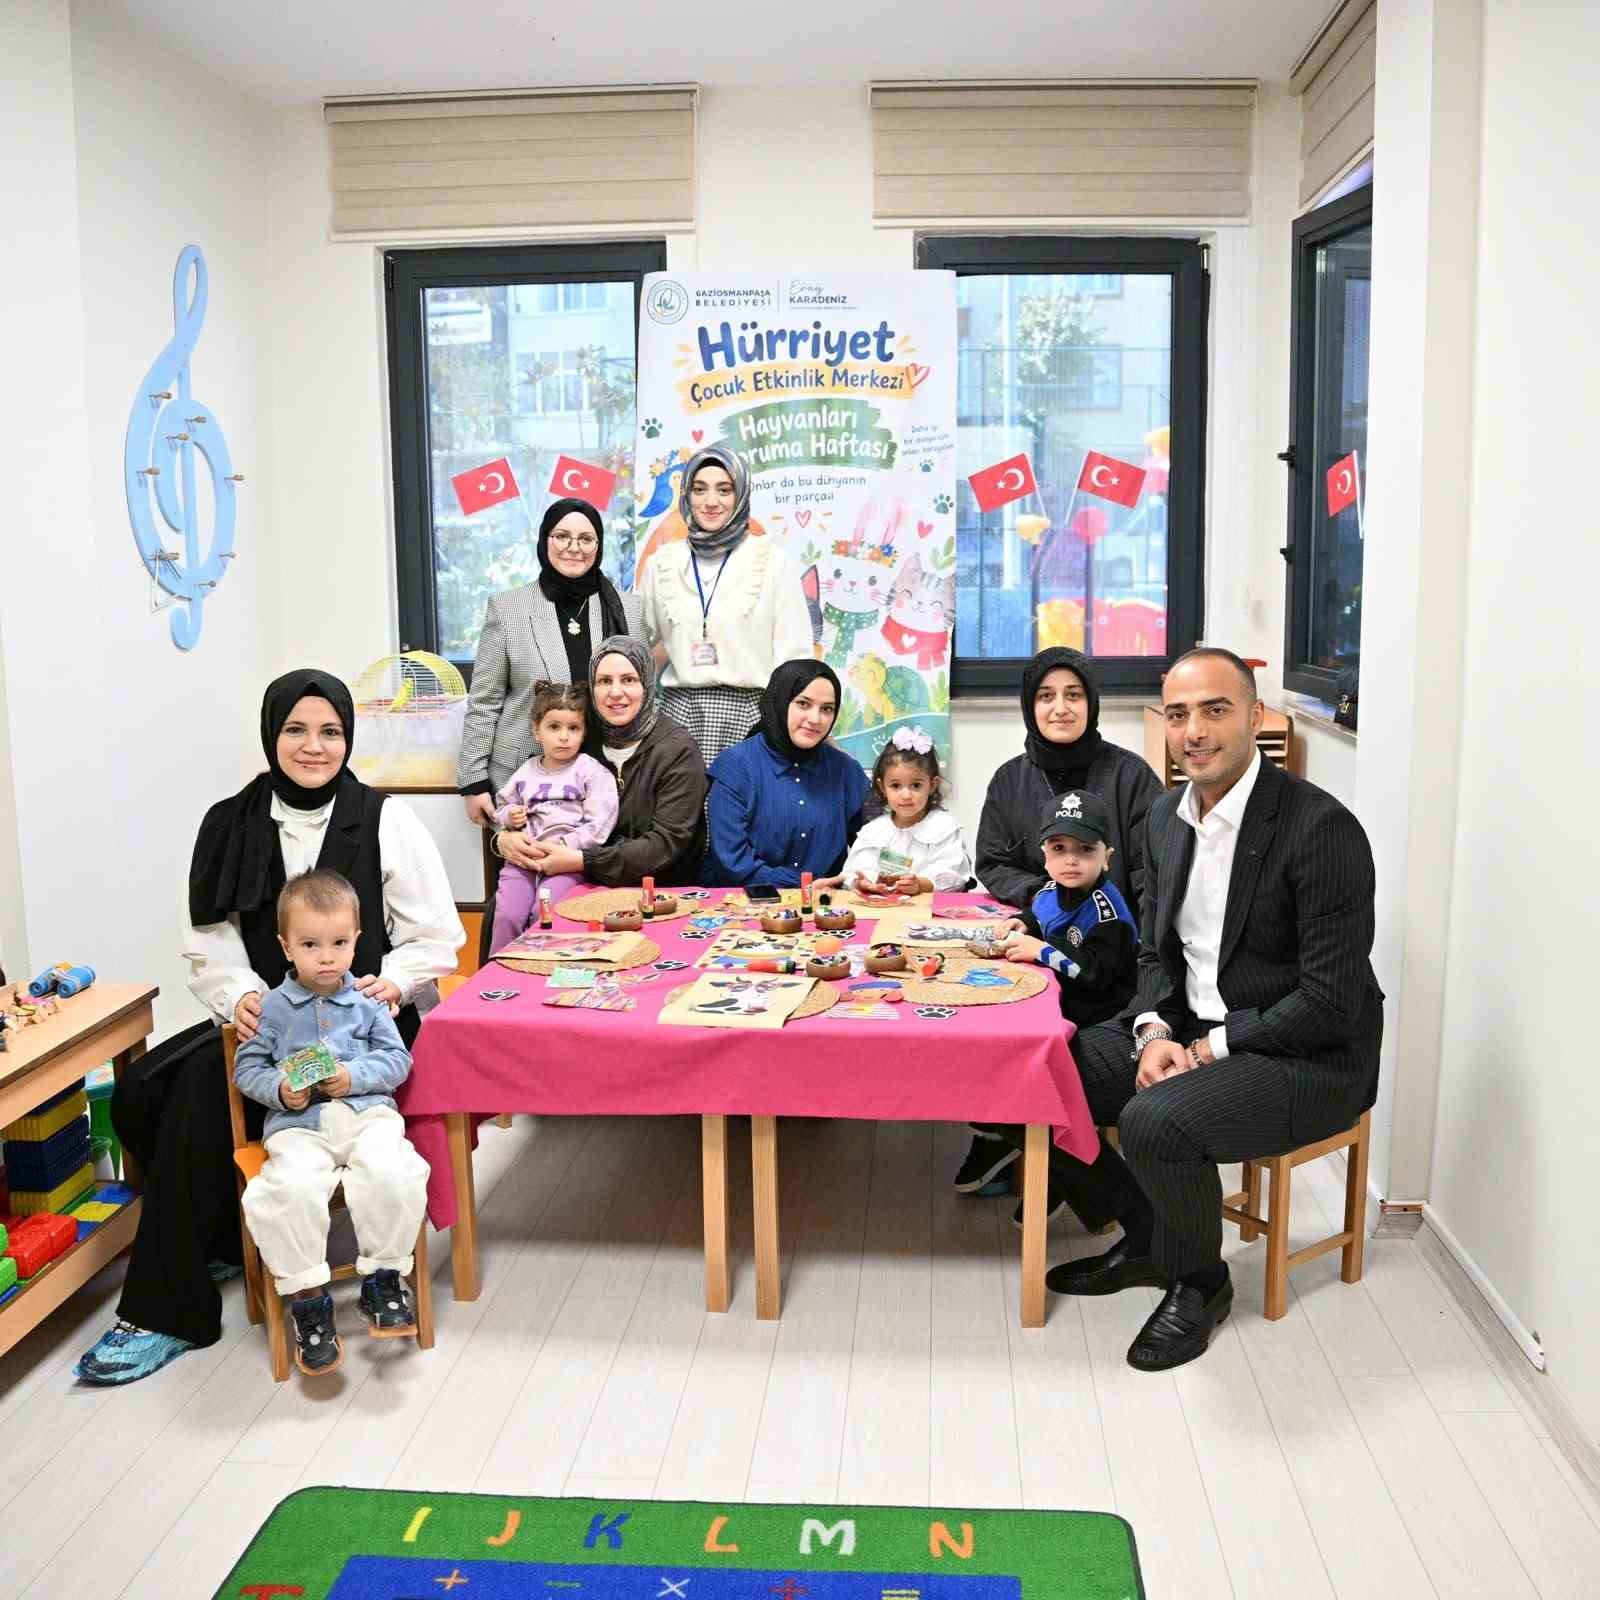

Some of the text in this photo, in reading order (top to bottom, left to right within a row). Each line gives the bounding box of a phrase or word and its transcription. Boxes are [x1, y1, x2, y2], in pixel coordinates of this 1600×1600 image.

[696, 297, 771, 307] BELEDİYESİ
[789, 293, 848, 304] KARADENİZ
[698, 321, 895, 371] Hürriyet
[691, 368, 904, 408] Çocuk Etkinlik Merkezi
[738, 405, 857, 441] Hayvanları
[738, 438, 804, 465] oruma
[811, 431, 888, 460] Haftası
[775, 491, 790, 504] bir
[780, 475, 794, 489] da
[799, 475, 812, 487] bu
[816, 474, 866, 488] dünyanın
[486, 1510, 520, 1546] J
[583, 1512, 629, 1549] K
[704, 1516, 739, 1552] L
[800, 1518, 857, 1555] M
[928, 1521, 975, 1559] N
